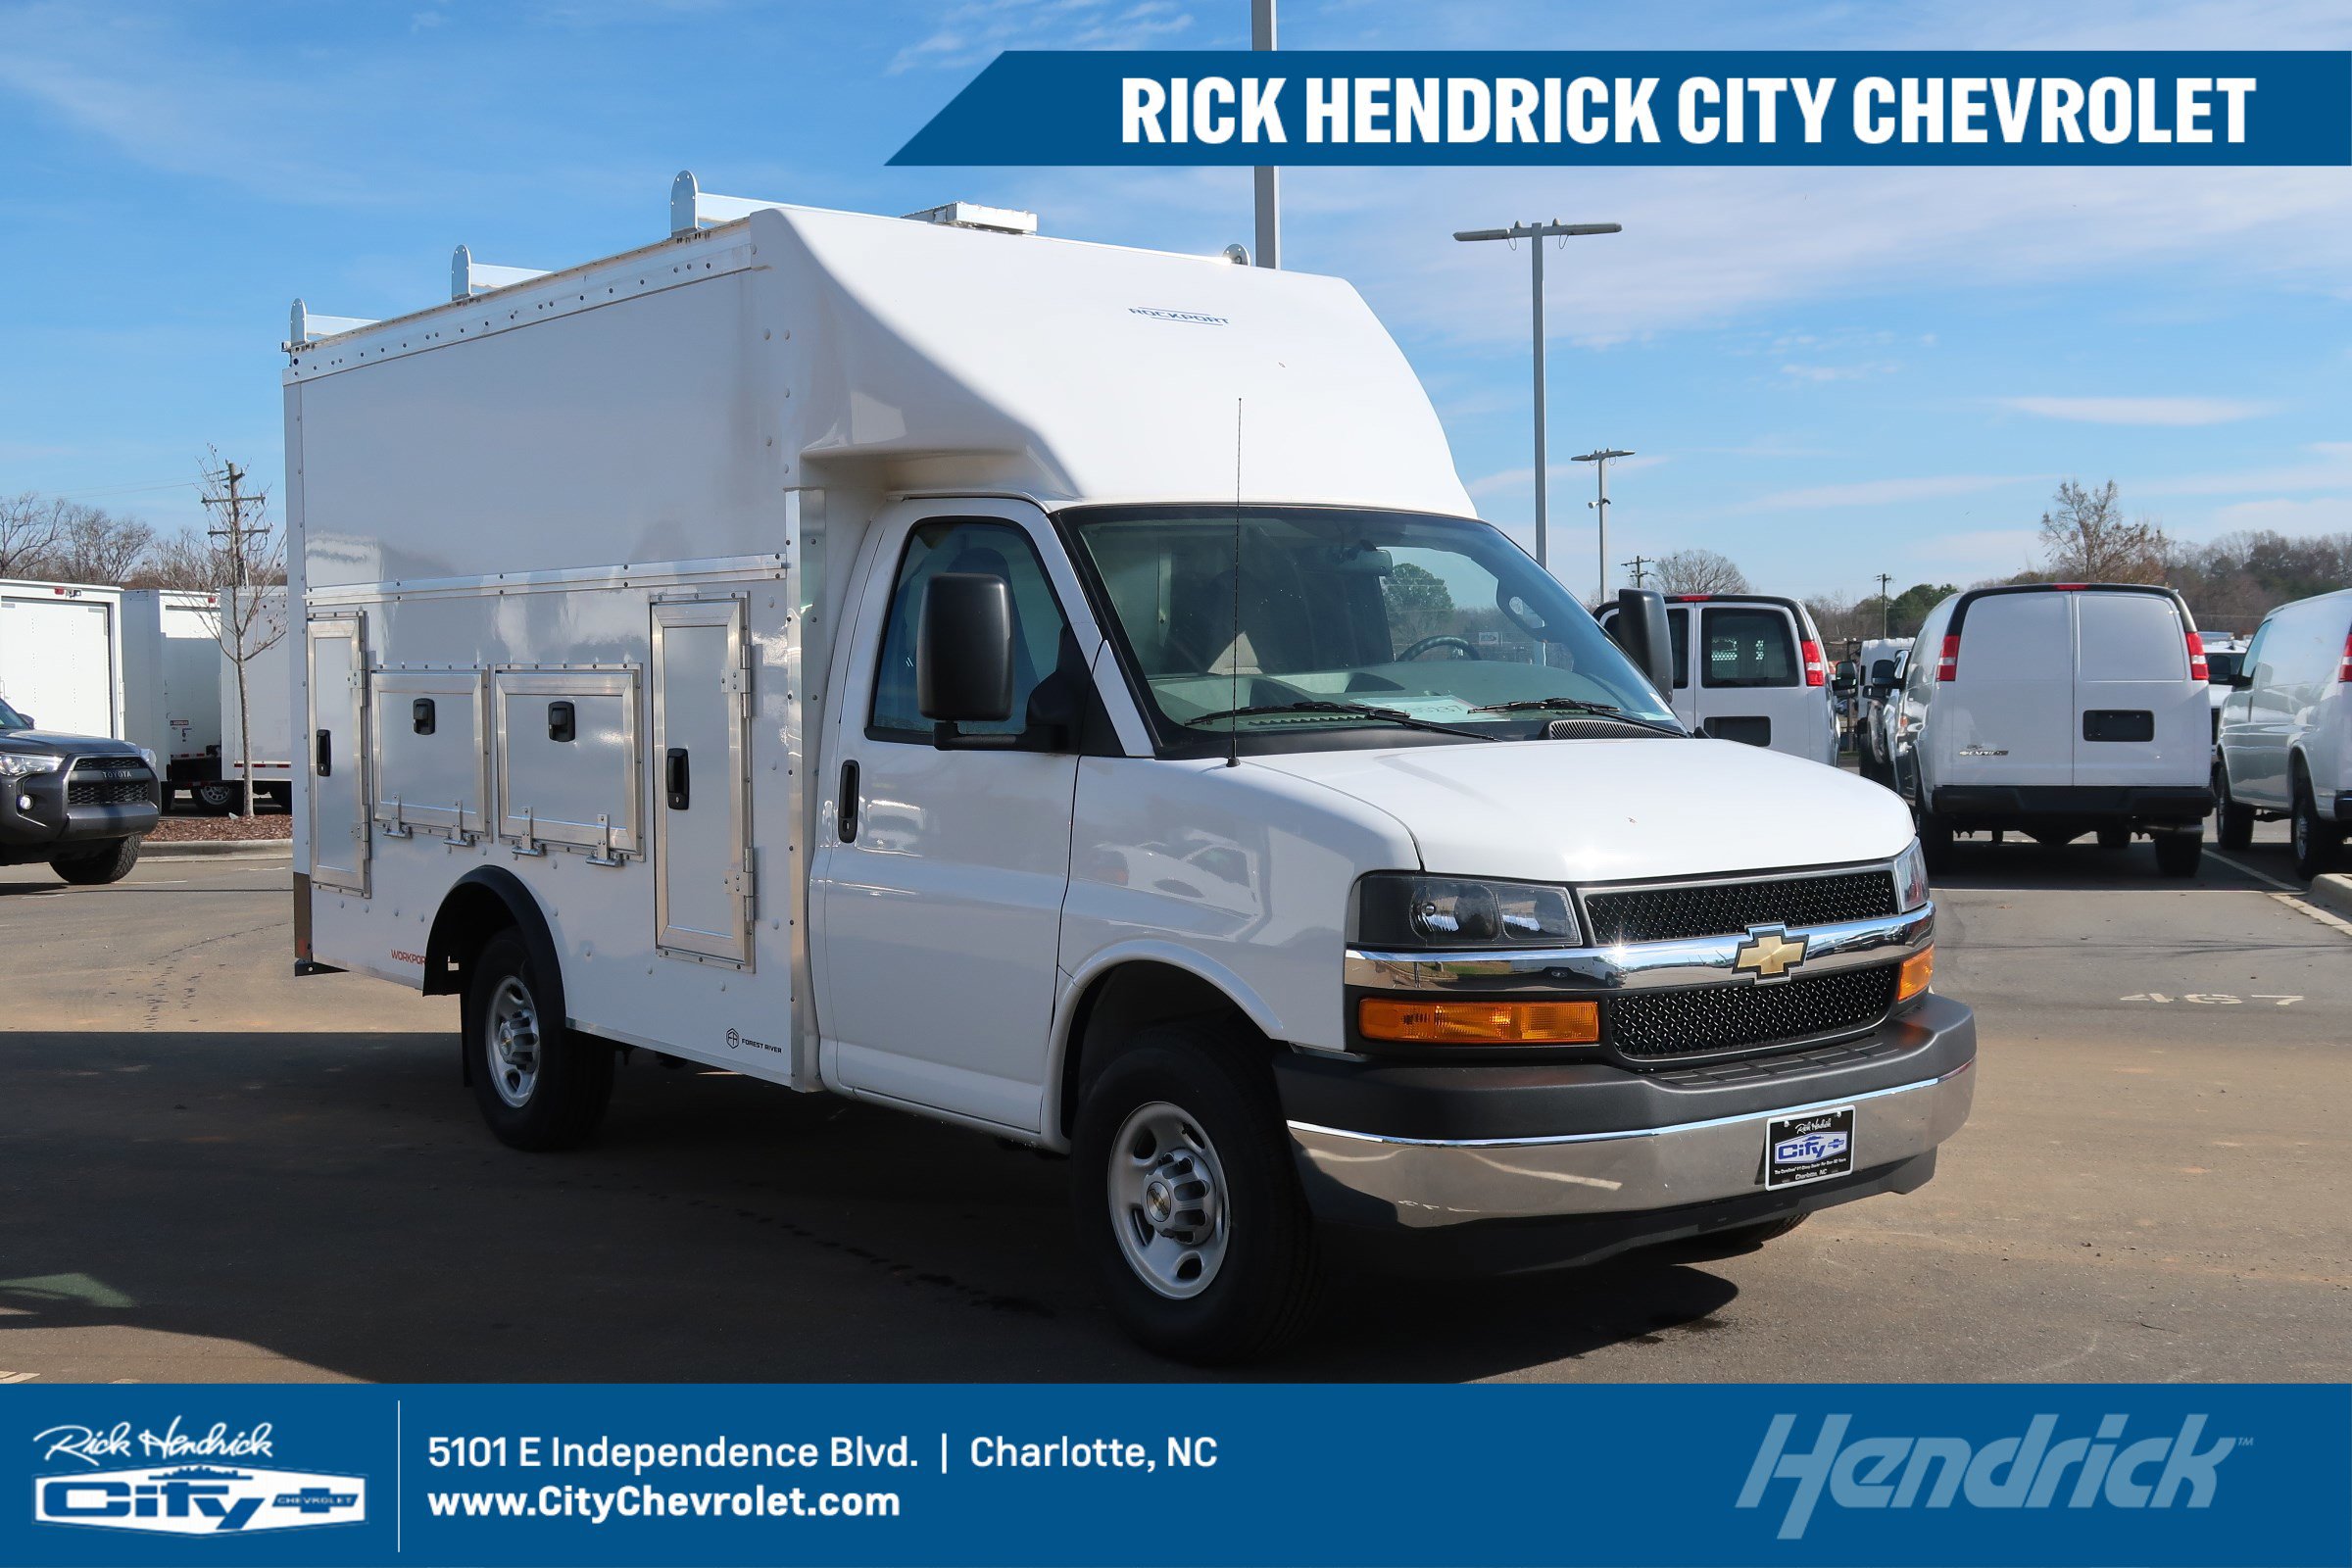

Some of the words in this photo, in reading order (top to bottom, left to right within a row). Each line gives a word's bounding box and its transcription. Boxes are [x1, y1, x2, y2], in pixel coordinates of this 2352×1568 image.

[1128, 307, 1229, 324] ROCKPORT
[391, 949, 426, 966] WORKPOR
[2120, 993, 2306, 1005] 467
[742, 1038, 764, 1050] FOREST
[764, 1044, 782, 1054] RIVER
[1778, 1141, 1827, 1160] City
